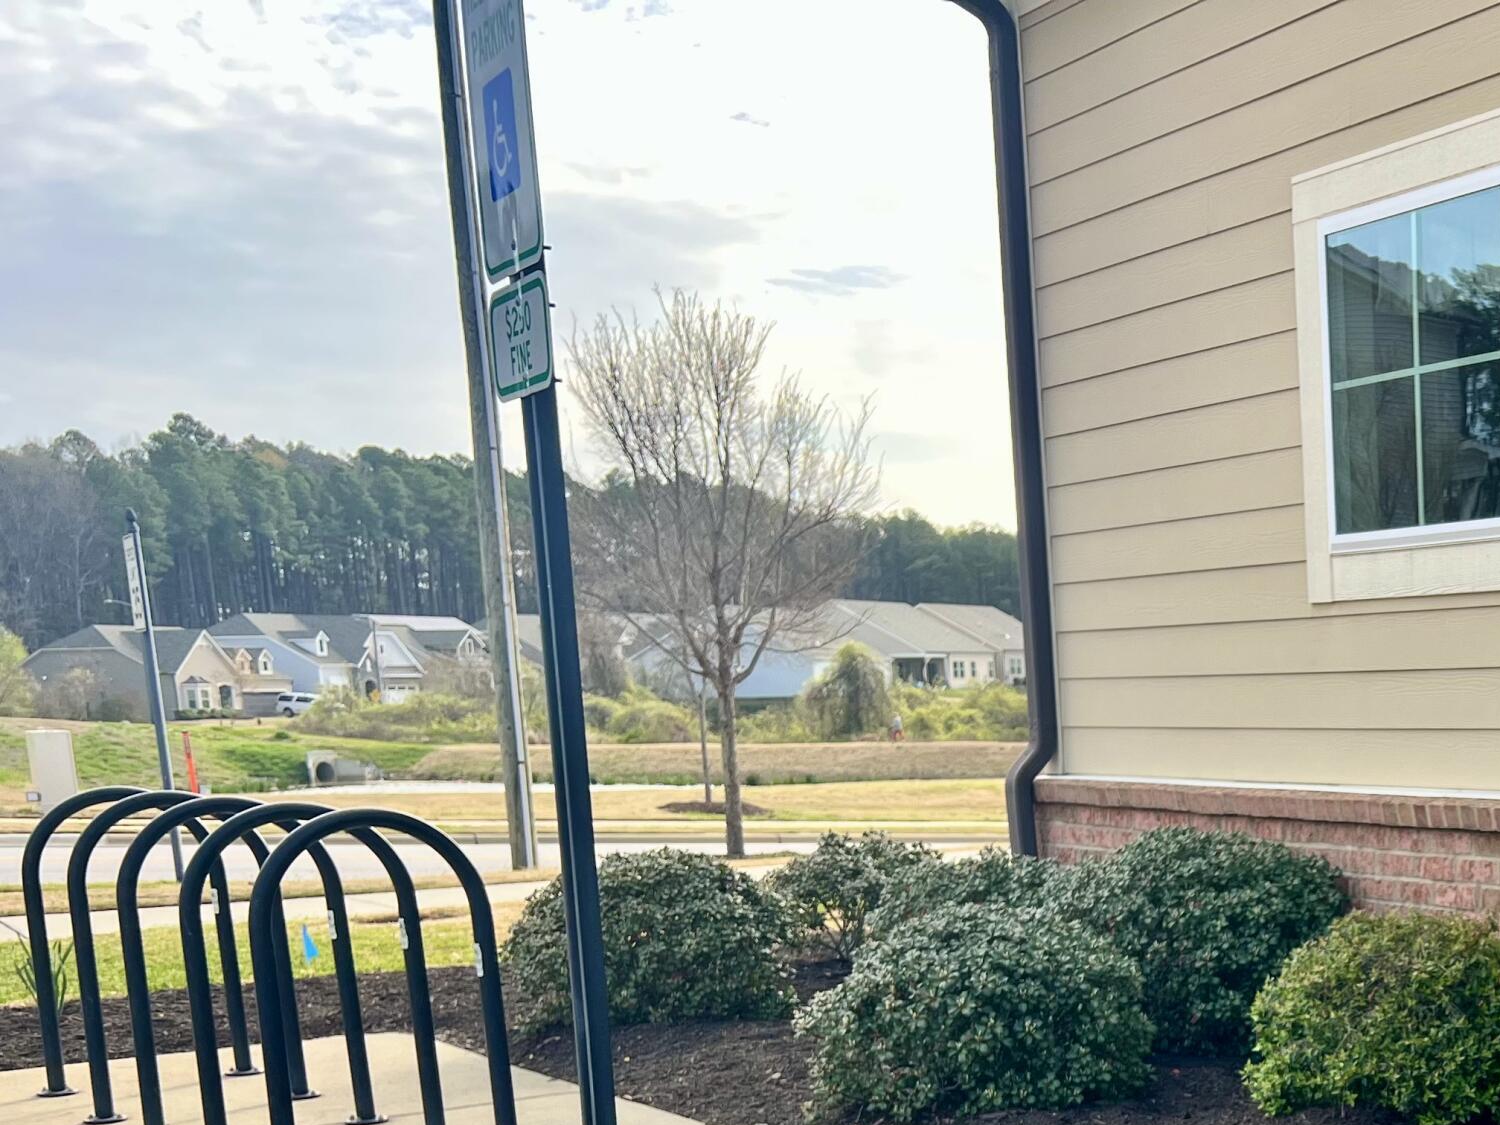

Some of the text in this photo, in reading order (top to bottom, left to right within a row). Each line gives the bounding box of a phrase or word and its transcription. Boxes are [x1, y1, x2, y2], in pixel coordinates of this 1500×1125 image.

[470, 1, 515, 72] PARKING
[505, 301, 531, 342] $250
[510, 340, 533, 376] FINE
